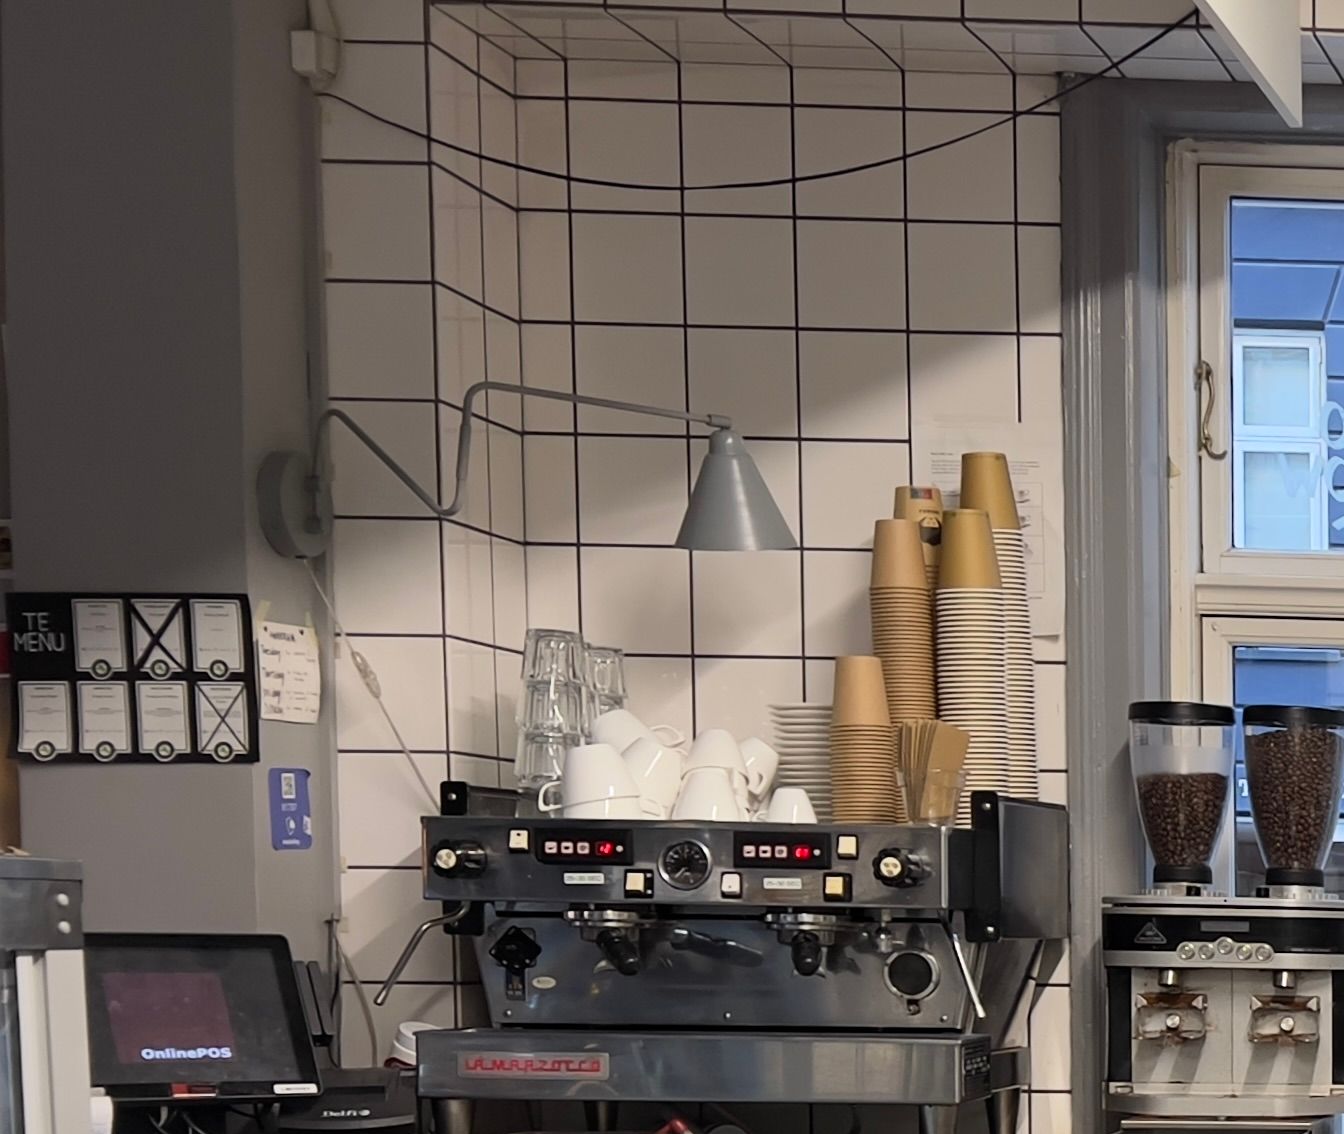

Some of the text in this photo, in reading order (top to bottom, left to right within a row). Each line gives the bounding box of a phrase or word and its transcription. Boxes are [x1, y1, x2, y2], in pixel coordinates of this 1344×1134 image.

[22, 611, 50, 632] TE
[13, 632, 65, 653] MENU
[140, 1046, 232, 1060] OnlinePOS
